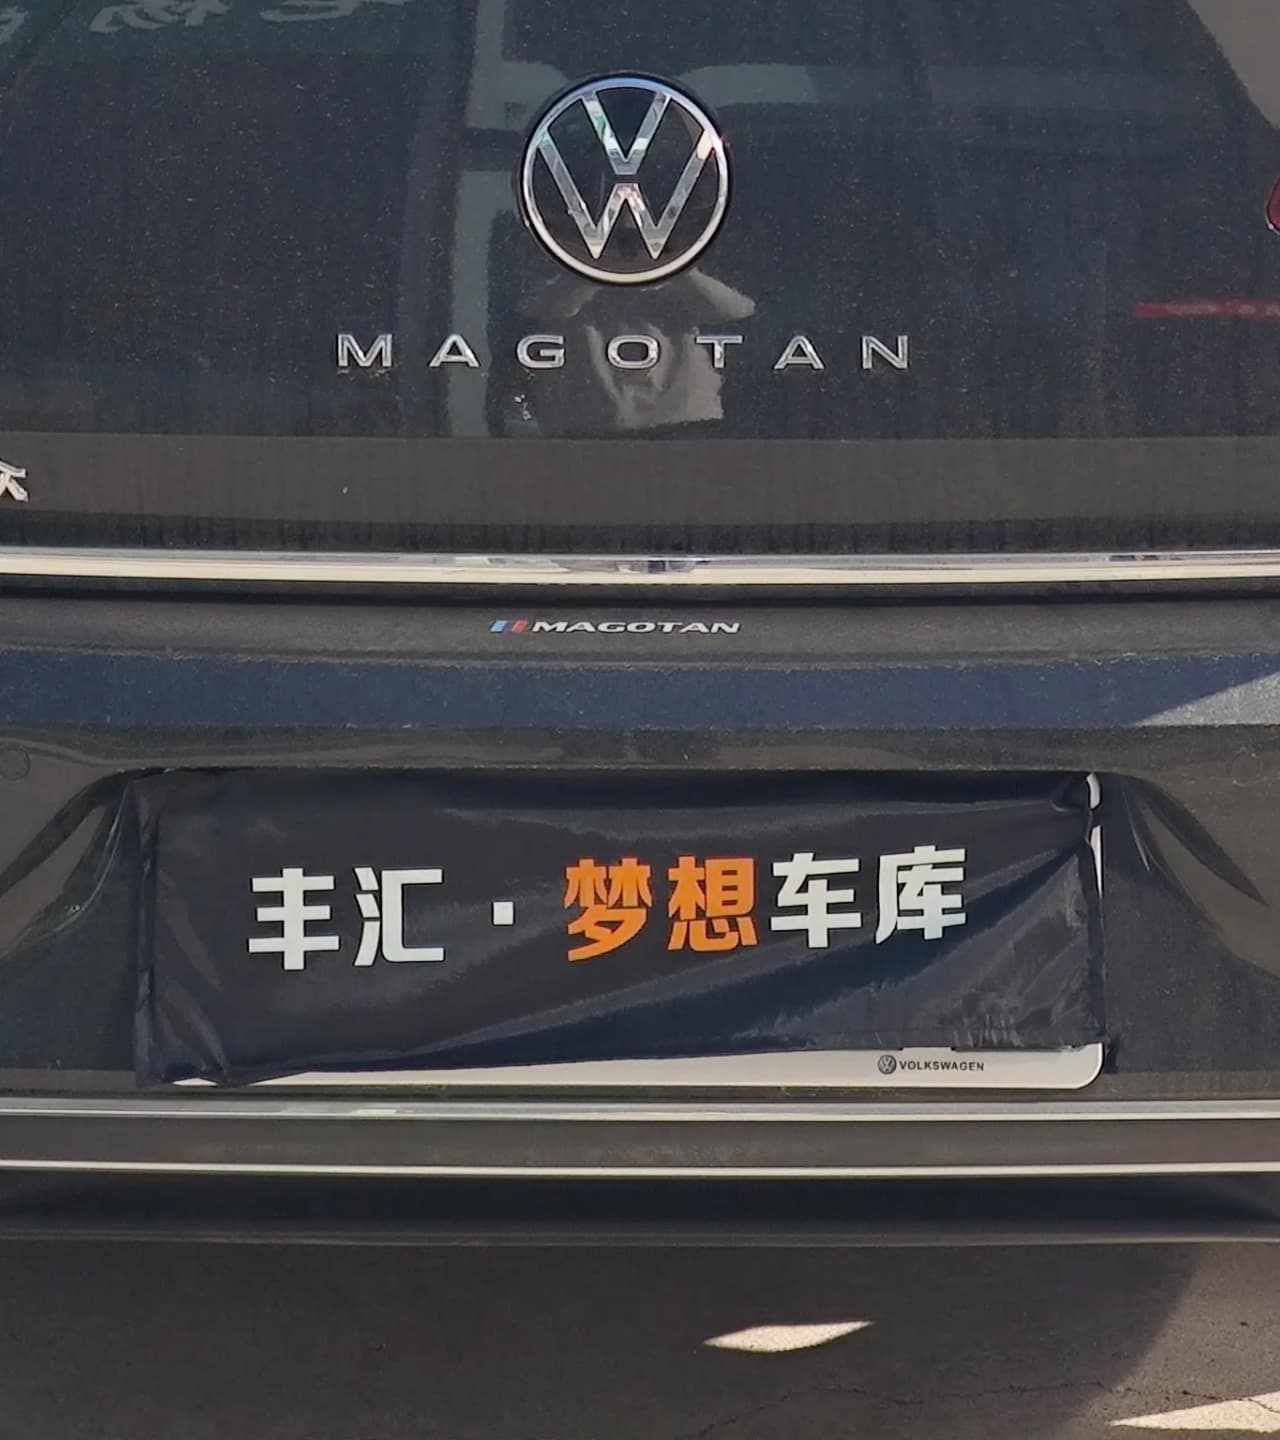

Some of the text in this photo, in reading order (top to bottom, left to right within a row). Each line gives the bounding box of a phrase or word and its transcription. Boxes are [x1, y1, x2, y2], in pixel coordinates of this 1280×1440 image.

[336, 331, 911, 372] MAGOTAN
[532, 621, 742, 634] MAGOTAN
[899, 1060, 985, 1072] VOLKSWAGEN
